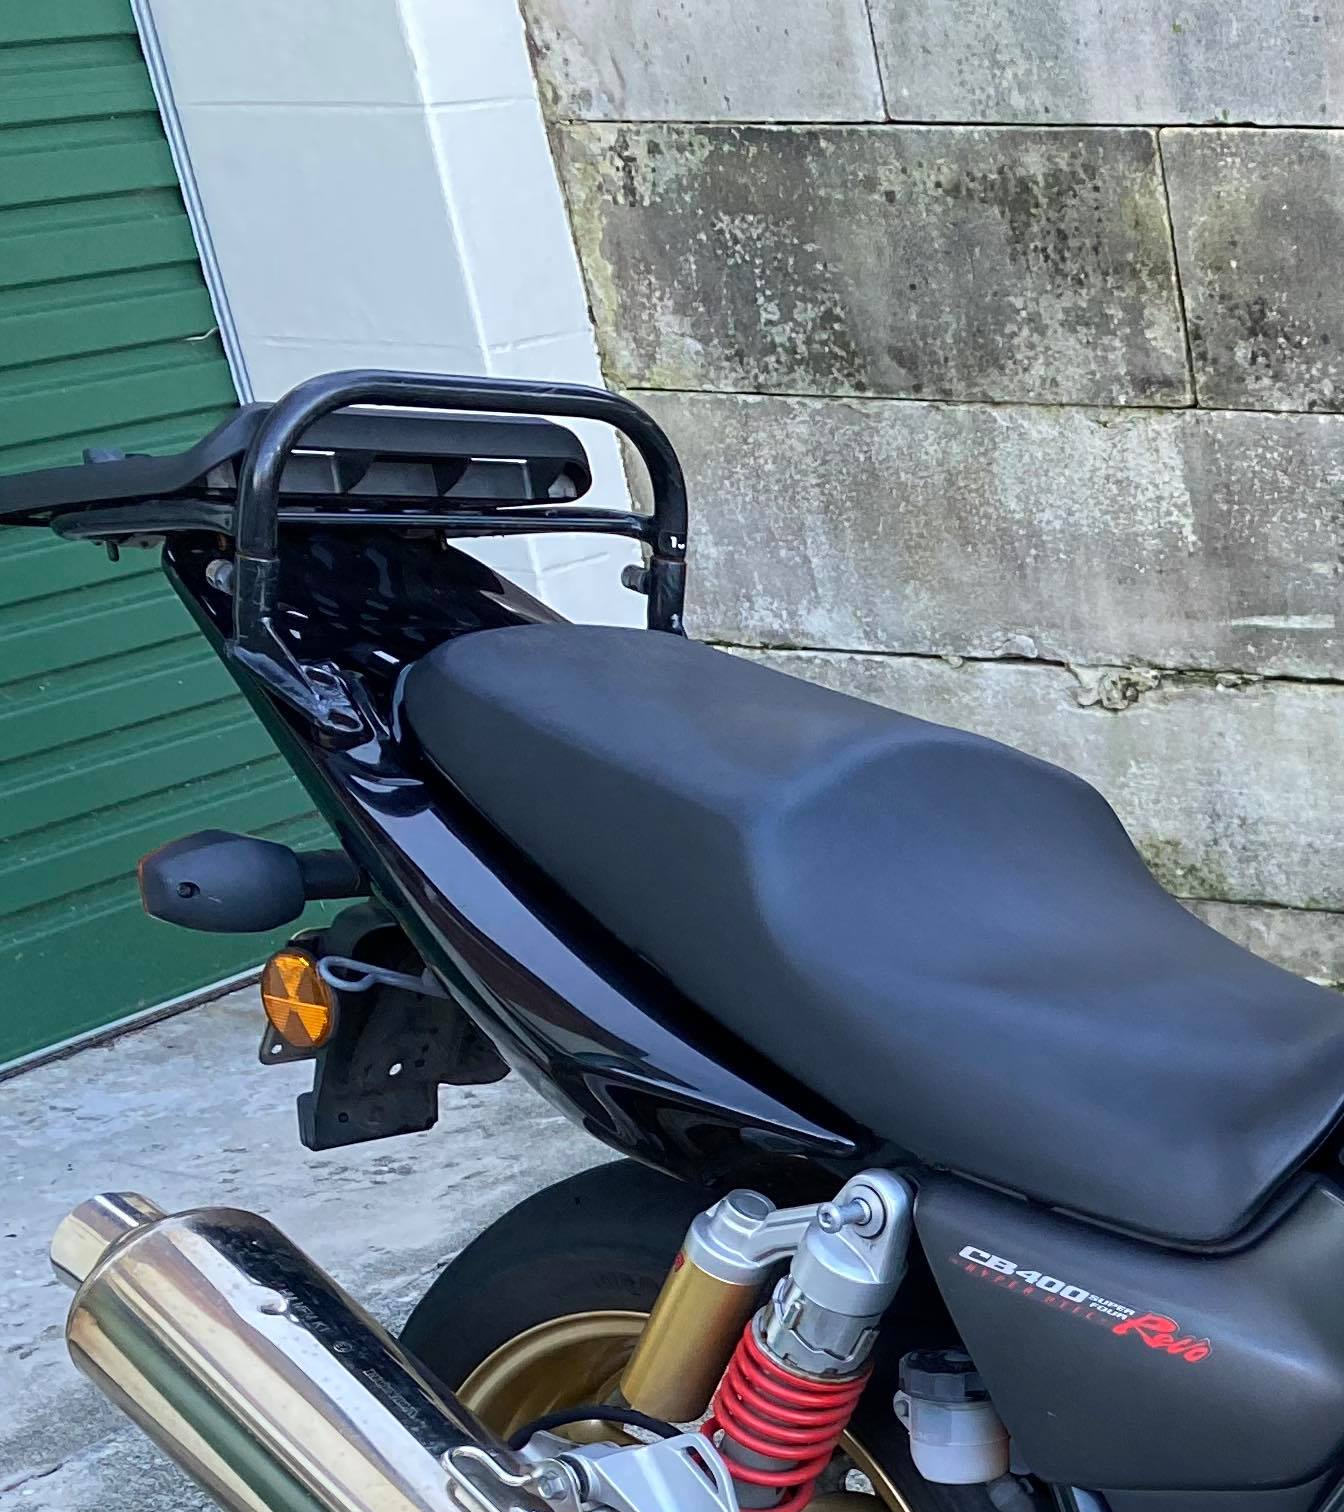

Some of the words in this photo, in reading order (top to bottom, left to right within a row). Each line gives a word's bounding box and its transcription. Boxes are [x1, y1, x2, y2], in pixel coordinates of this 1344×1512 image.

[958, 1245, 1090, 1304] CB400
[1087, 1294, 1136, 1316] SUPER
[1089, 1302, 1129, 1321] FOUR
[1112, 1311, 1213, 1364] Revo
